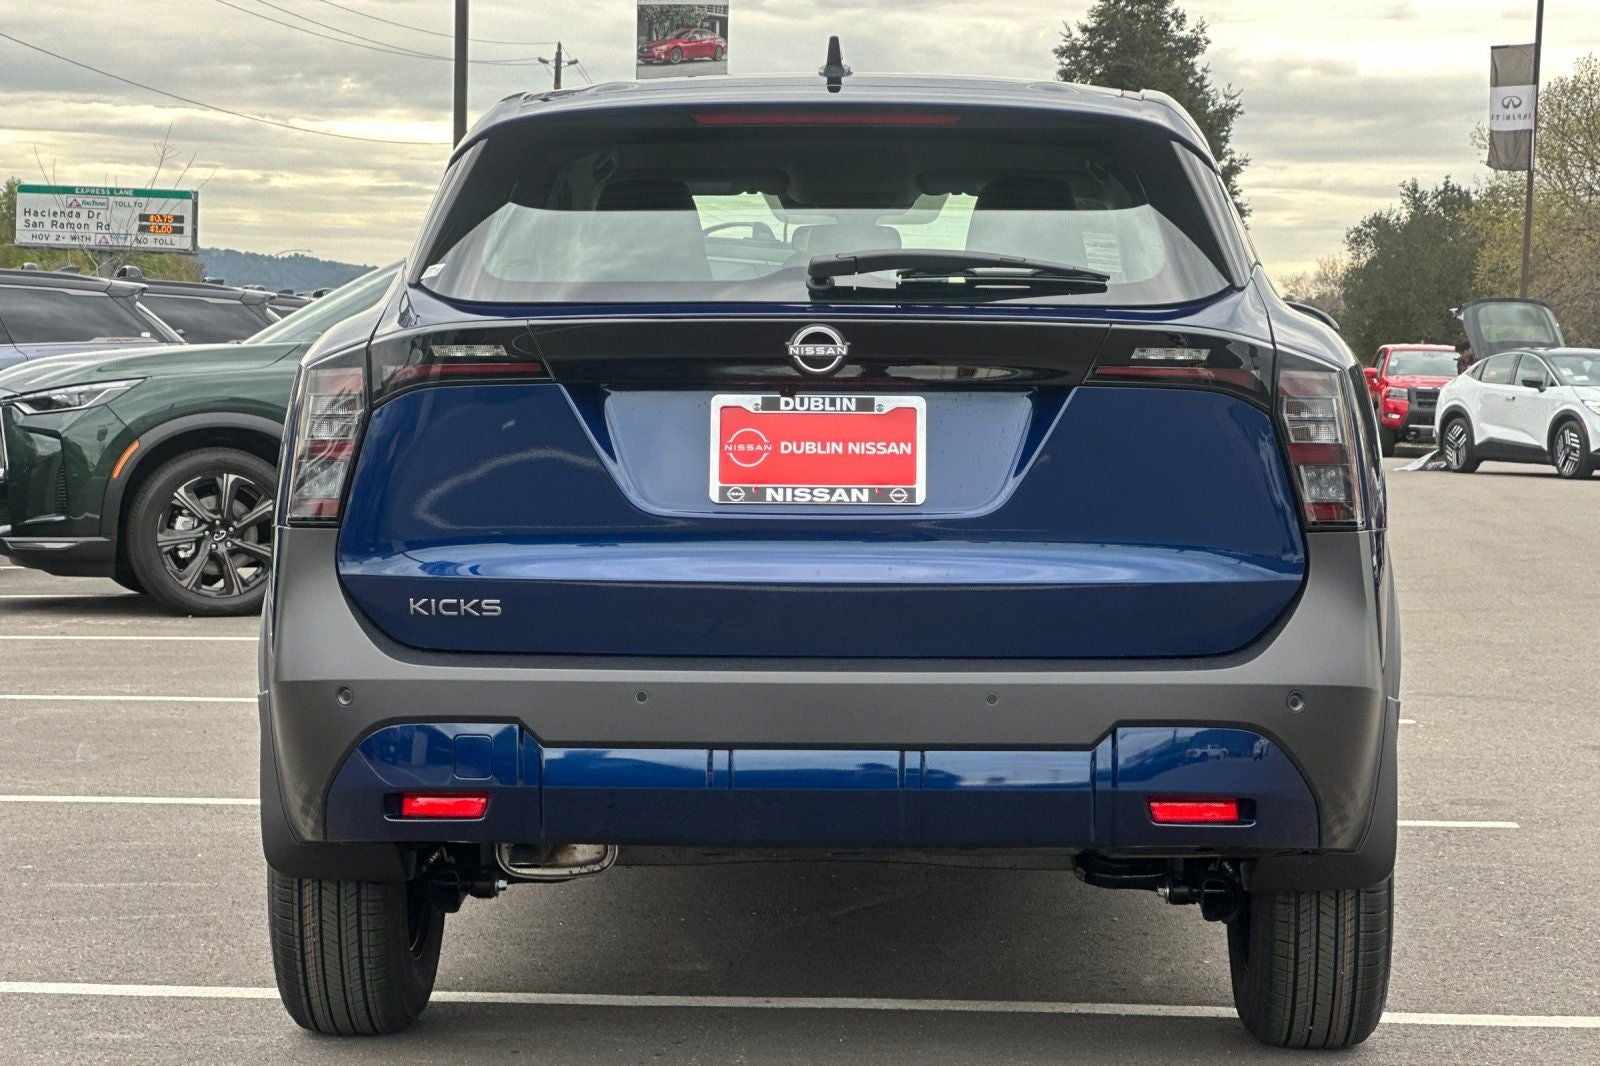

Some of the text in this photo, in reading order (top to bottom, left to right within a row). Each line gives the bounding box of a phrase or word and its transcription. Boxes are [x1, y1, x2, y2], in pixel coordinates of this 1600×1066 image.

[75, 187, 134, 196] EXPRESS LANE
[23, 207, 102, 219] Hacienda Dr
[23, 218, 110, 231] San Ramon Rd
[31, 233, 50, 241] HOV
[70, 234, 91, 242] WITH
[136, 237, 148, 245] NO
[153, 237, 176, 246] TOLL
[789, 346, 847, 355] NISSAN
[780, 396, 856, 411] DUBLIN
[780, 441, 912, 455] DUBLIN NISSAN
[765, 487, 869, 502] NISSAN
[409, 598, 502, 616] KICKS
